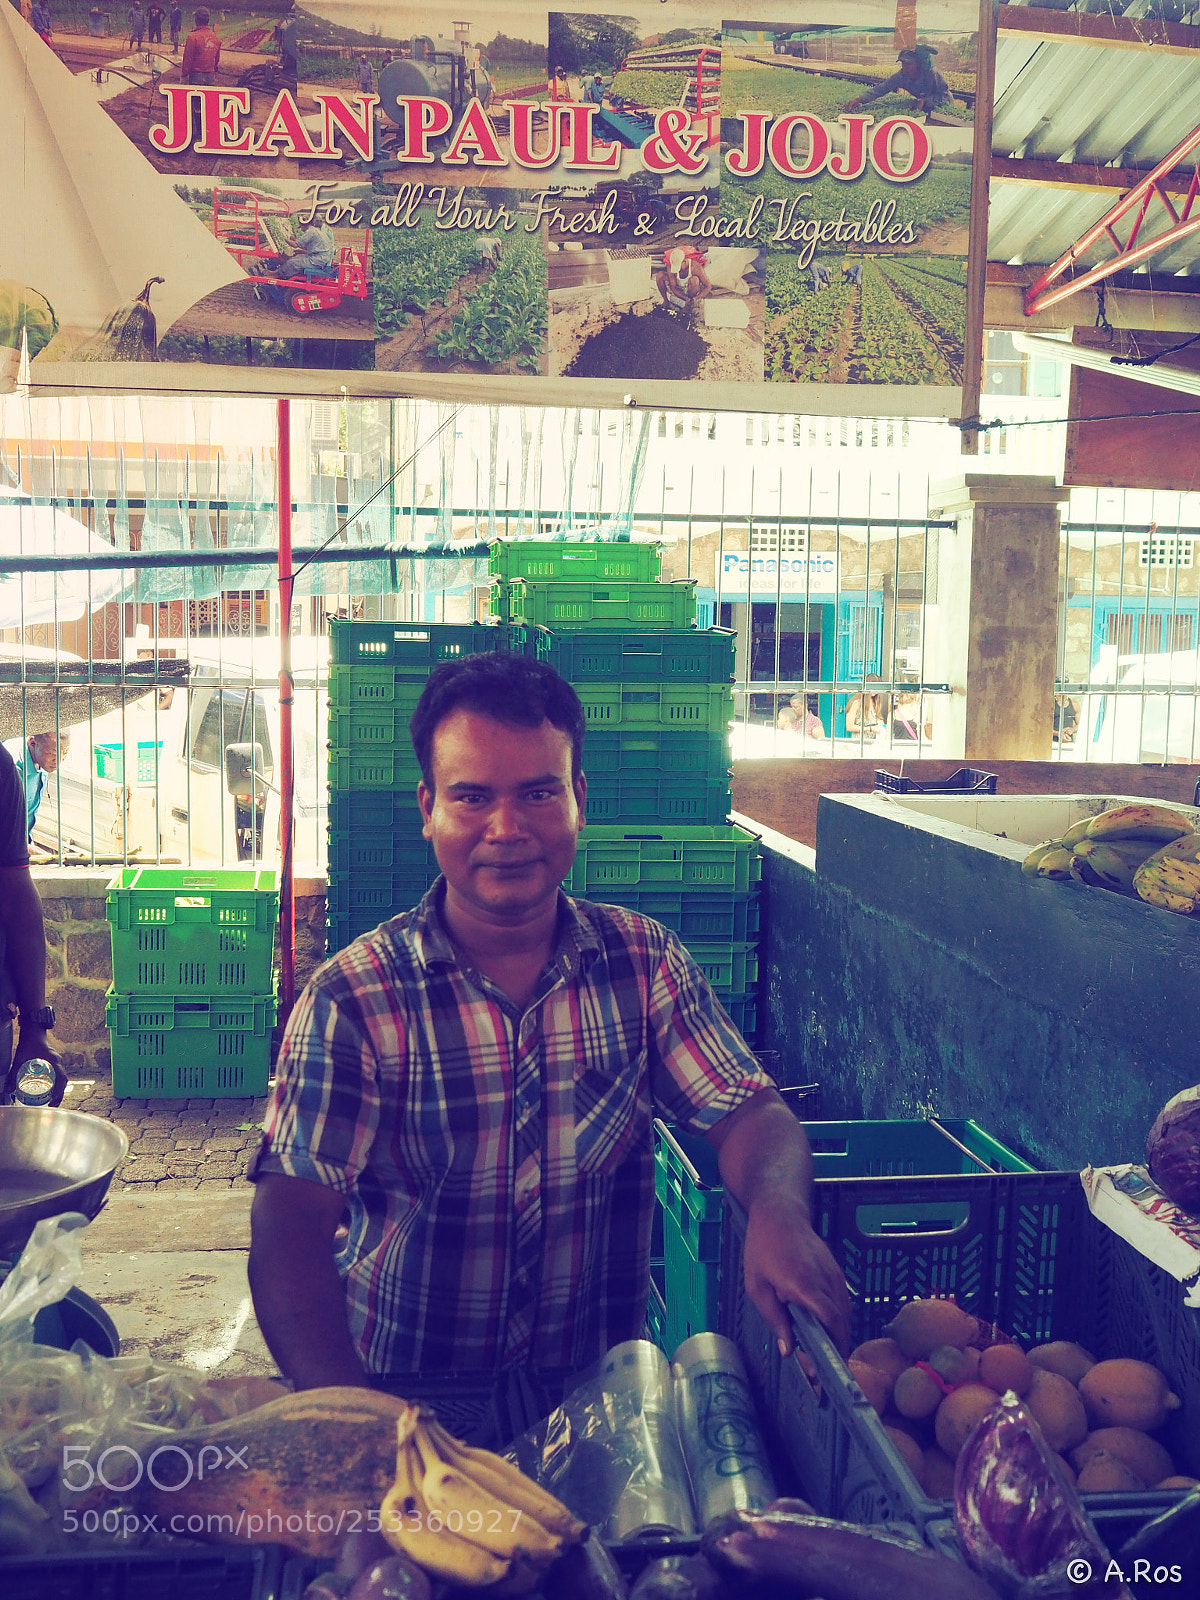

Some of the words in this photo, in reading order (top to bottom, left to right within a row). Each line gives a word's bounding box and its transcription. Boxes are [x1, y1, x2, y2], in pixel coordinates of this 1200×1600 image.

[149, 83, 381, 162] JEAN
[397, 94, 622, 170] PAUL
[640, 106, 710, 175] &
[724, 110, 932, 183] JOJO
[298, 181, 363, 226] For
[370, 181, 425, 228] all
[428, 185, 517, 231] Your
[524, 189, 620, 234] Fresh
[633, 212, 658, 236] &
[674, 194, 765, 239] Local
[769, 191, 918, 270] Vegetables
[723, 554, 835, 573] Panasonic
